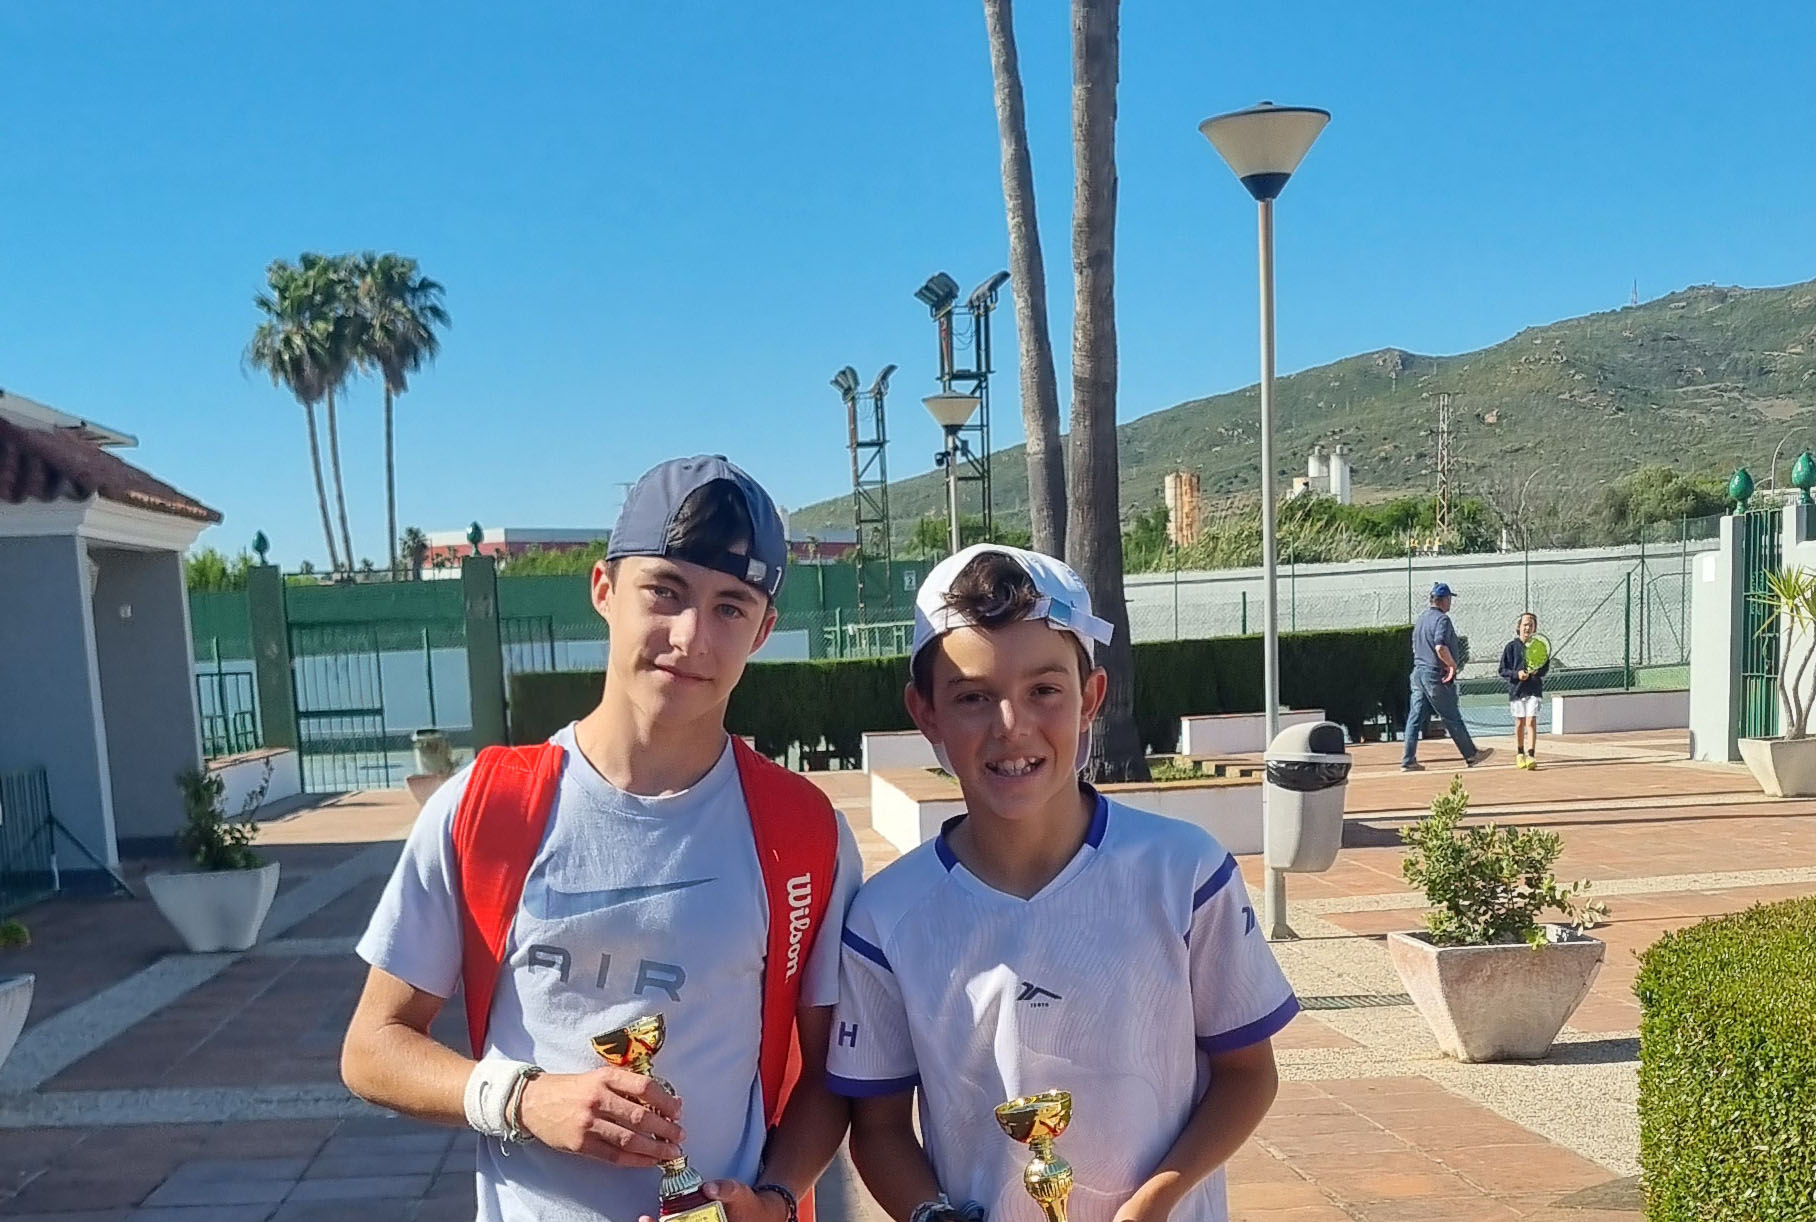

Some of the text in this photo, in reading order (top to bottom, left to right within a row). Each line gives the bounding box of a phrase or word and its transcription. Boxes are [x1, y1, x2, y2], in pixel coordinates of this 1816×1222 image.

[786, 872, 811, 979] Wilson
[527, 943, 687, 1003] AIR
[838, 1021, 858, 1048] H
